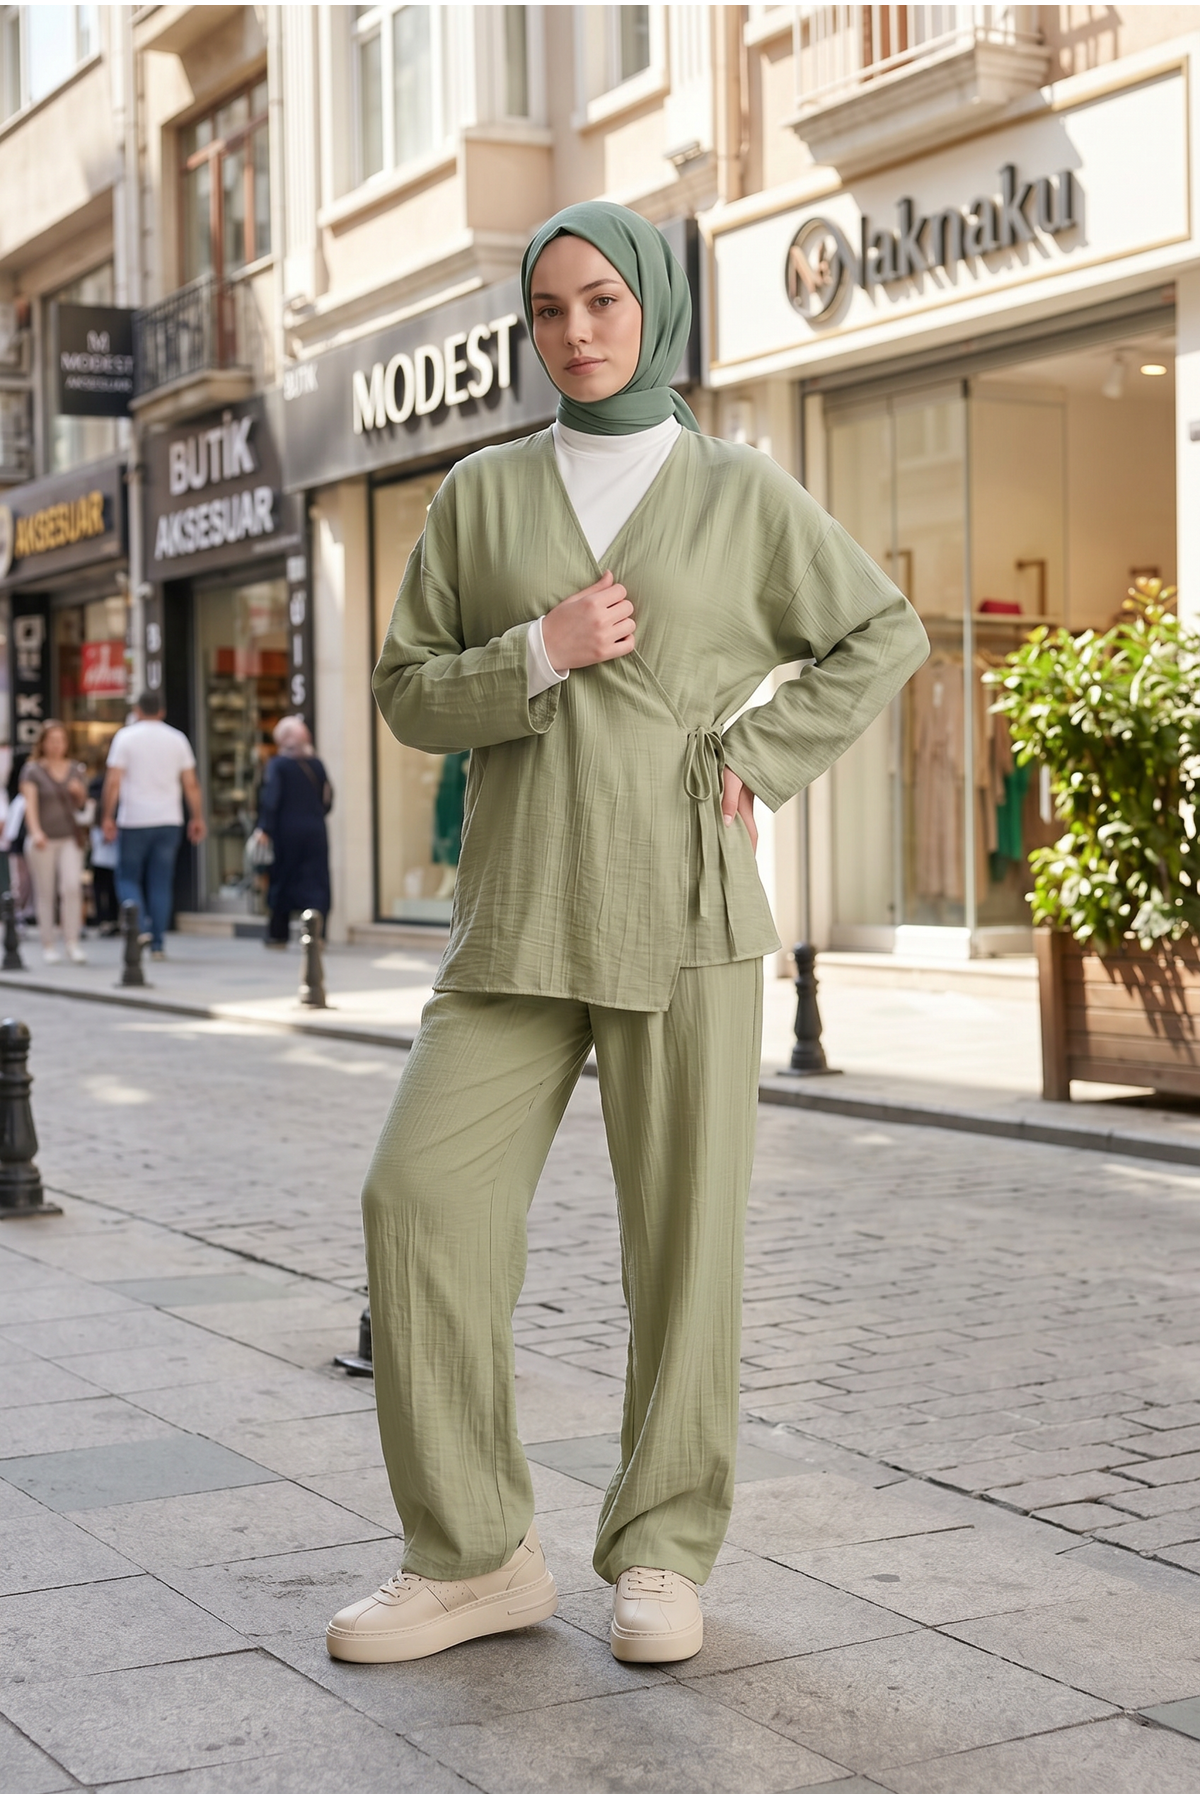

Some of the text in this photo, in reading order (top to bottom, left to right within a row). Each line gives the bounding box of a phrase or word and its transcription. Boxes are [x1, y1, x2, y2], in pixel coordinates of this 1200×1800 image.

[858, 163, 1075, 289] laknaku
[353, 312, 518, 435] MODEST
[14, 489, 105, 559] AKSESUAR
[154, 486, 274, 561] AKSESUAR
